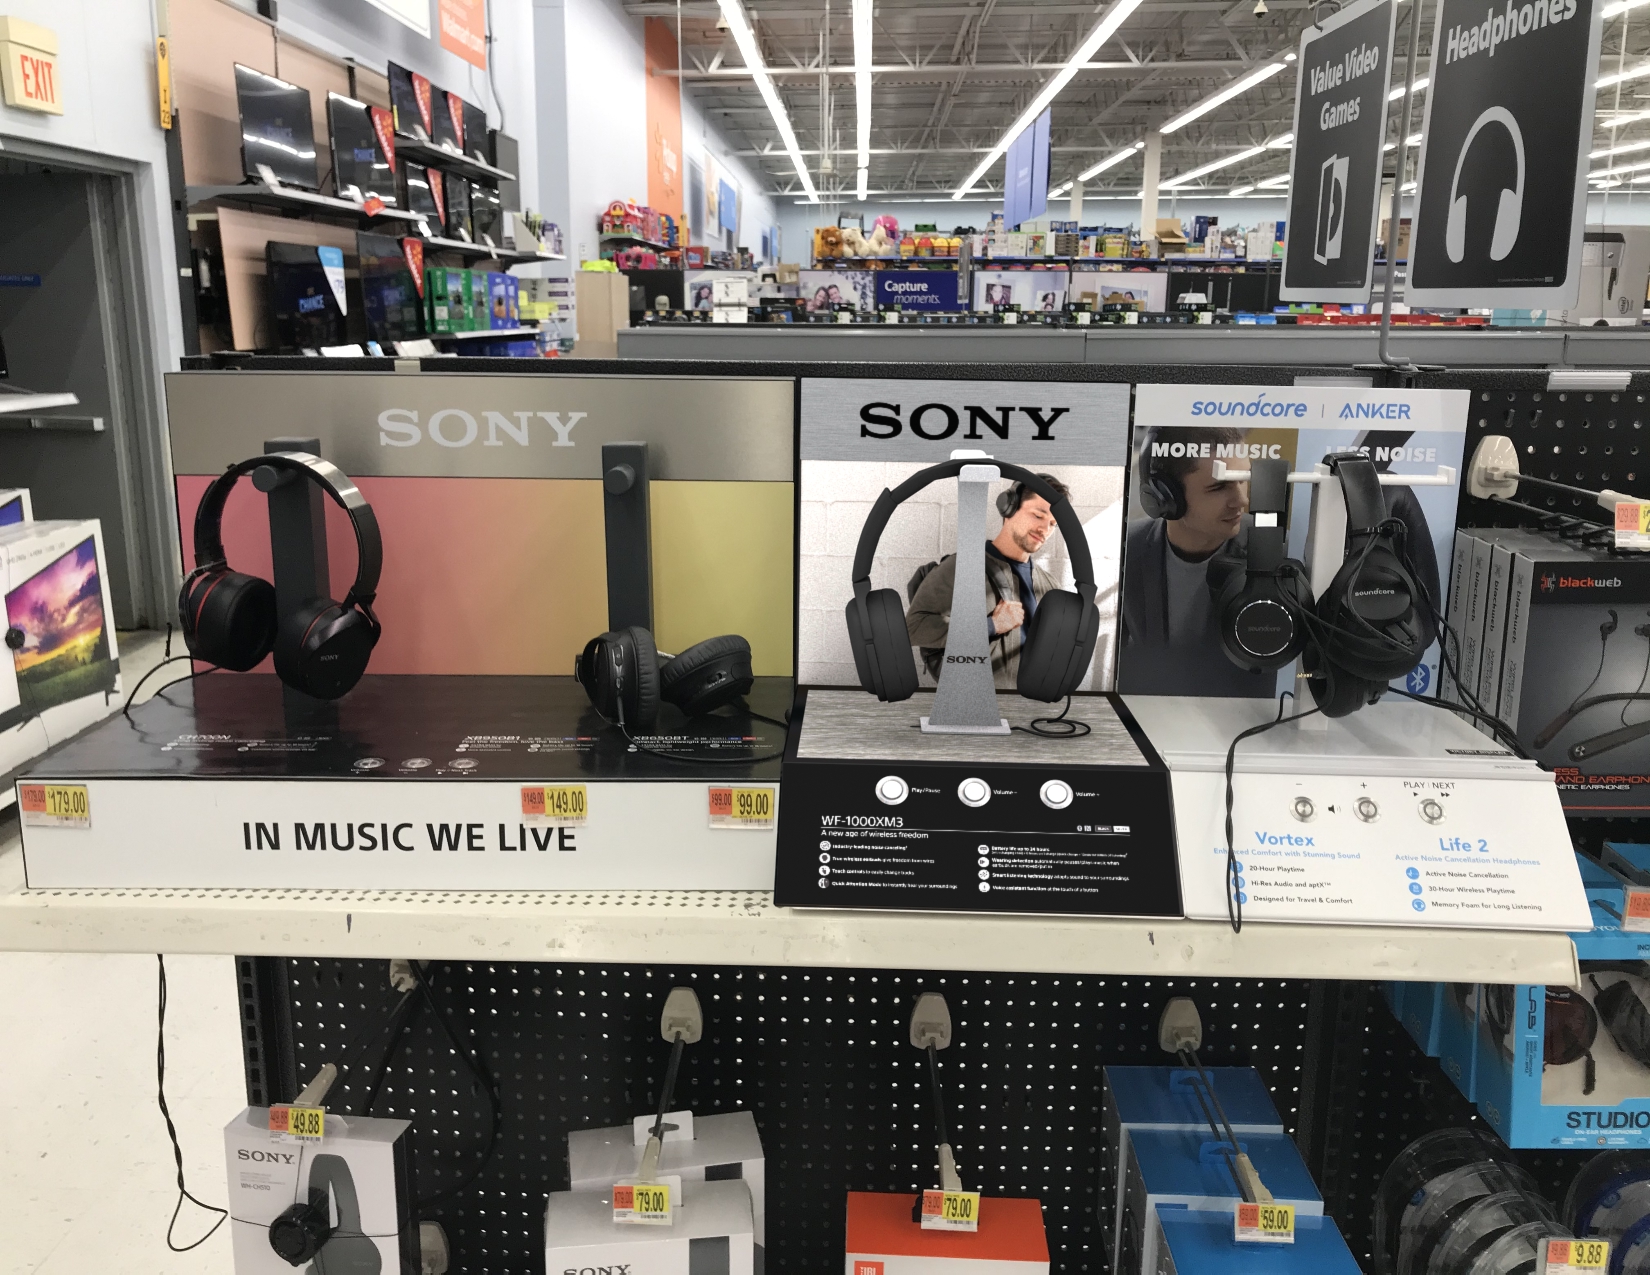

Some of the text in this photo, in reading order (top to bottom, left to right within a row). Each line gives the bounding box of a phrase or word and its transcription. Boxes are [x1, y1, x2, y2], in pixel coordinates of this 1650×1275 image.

[1446, 0, 1577, 65] Headphones
[1310, 42, 1379, 96] Value Video
[20, 54, 55, 104] EXIT
[1320, 96, 1361, 131] Games
[884, 280, 929, 294] Capture
[1191, 393, 1308, 418] soundcore
[1339, 404, 1411, 421] ANKER
[378, 408, 588, 448] SONY
[860, 402, 1070, 441] SONY
[1152, 442, 1282, 460] MORE MUSIC
[1376, 447, 1437, 463] NOISE
[1560, 577, 1622, 588] blackweb
[1355, 588, 1395, 597] soundcore
[947, 656, 988, 664] SONY
[1403, 781, 1425, 789] PLAY
[48, 790, 86, 814] $179.00
[547, 790, 584, 814] $149.00
[712, 793, 769, 816] $99.00 $99.00
[822, 816, 904, 828] WF-1000XM3
[243, 822, 577, 852] IN MUSIC WE LIVE
[1255, 831, 1316, 847] Vortex
[1439, 837, 1490, 853] Life 2
[1214, 848, 1250, 856] Enhnced
[1252, 849, 1282, 857] Comfort
[1284, 850, 1301, 858] with
[1302, 851, 1336, 860] Stunning
[1395, 854, 1419, 862] Active
[1444, 856, 1491, 864] Cancellation
[1493, 858, 1541, 866] Headphones
[1277, 866, 1305, 874] Playtime
[1457, 886, 1485, 894] Wireless
[1486, 887, 1516, 895] Playtime
[1432, 901, 1460, 909] Memory
[1493, 903, 1511, 911] Long
[1512, 904, 1543, 912] Listening
[1528, 986, 1538, 1030] LAB
[292, 1113, 320, 1134] $49.88
[1566, 1111, 1650, 1129] STUDIO
[237, 1149, 295, 1165] SONY
[240, 1183, 271, 1191] WH-CH510
[636, 1192, 664, 1212] $79.00
[944, 1198, 972, 1218] $79.00
[1261, 1210, 1289, 1230] $59.00
[1575, 1244, 1602, 1264] $9.88
